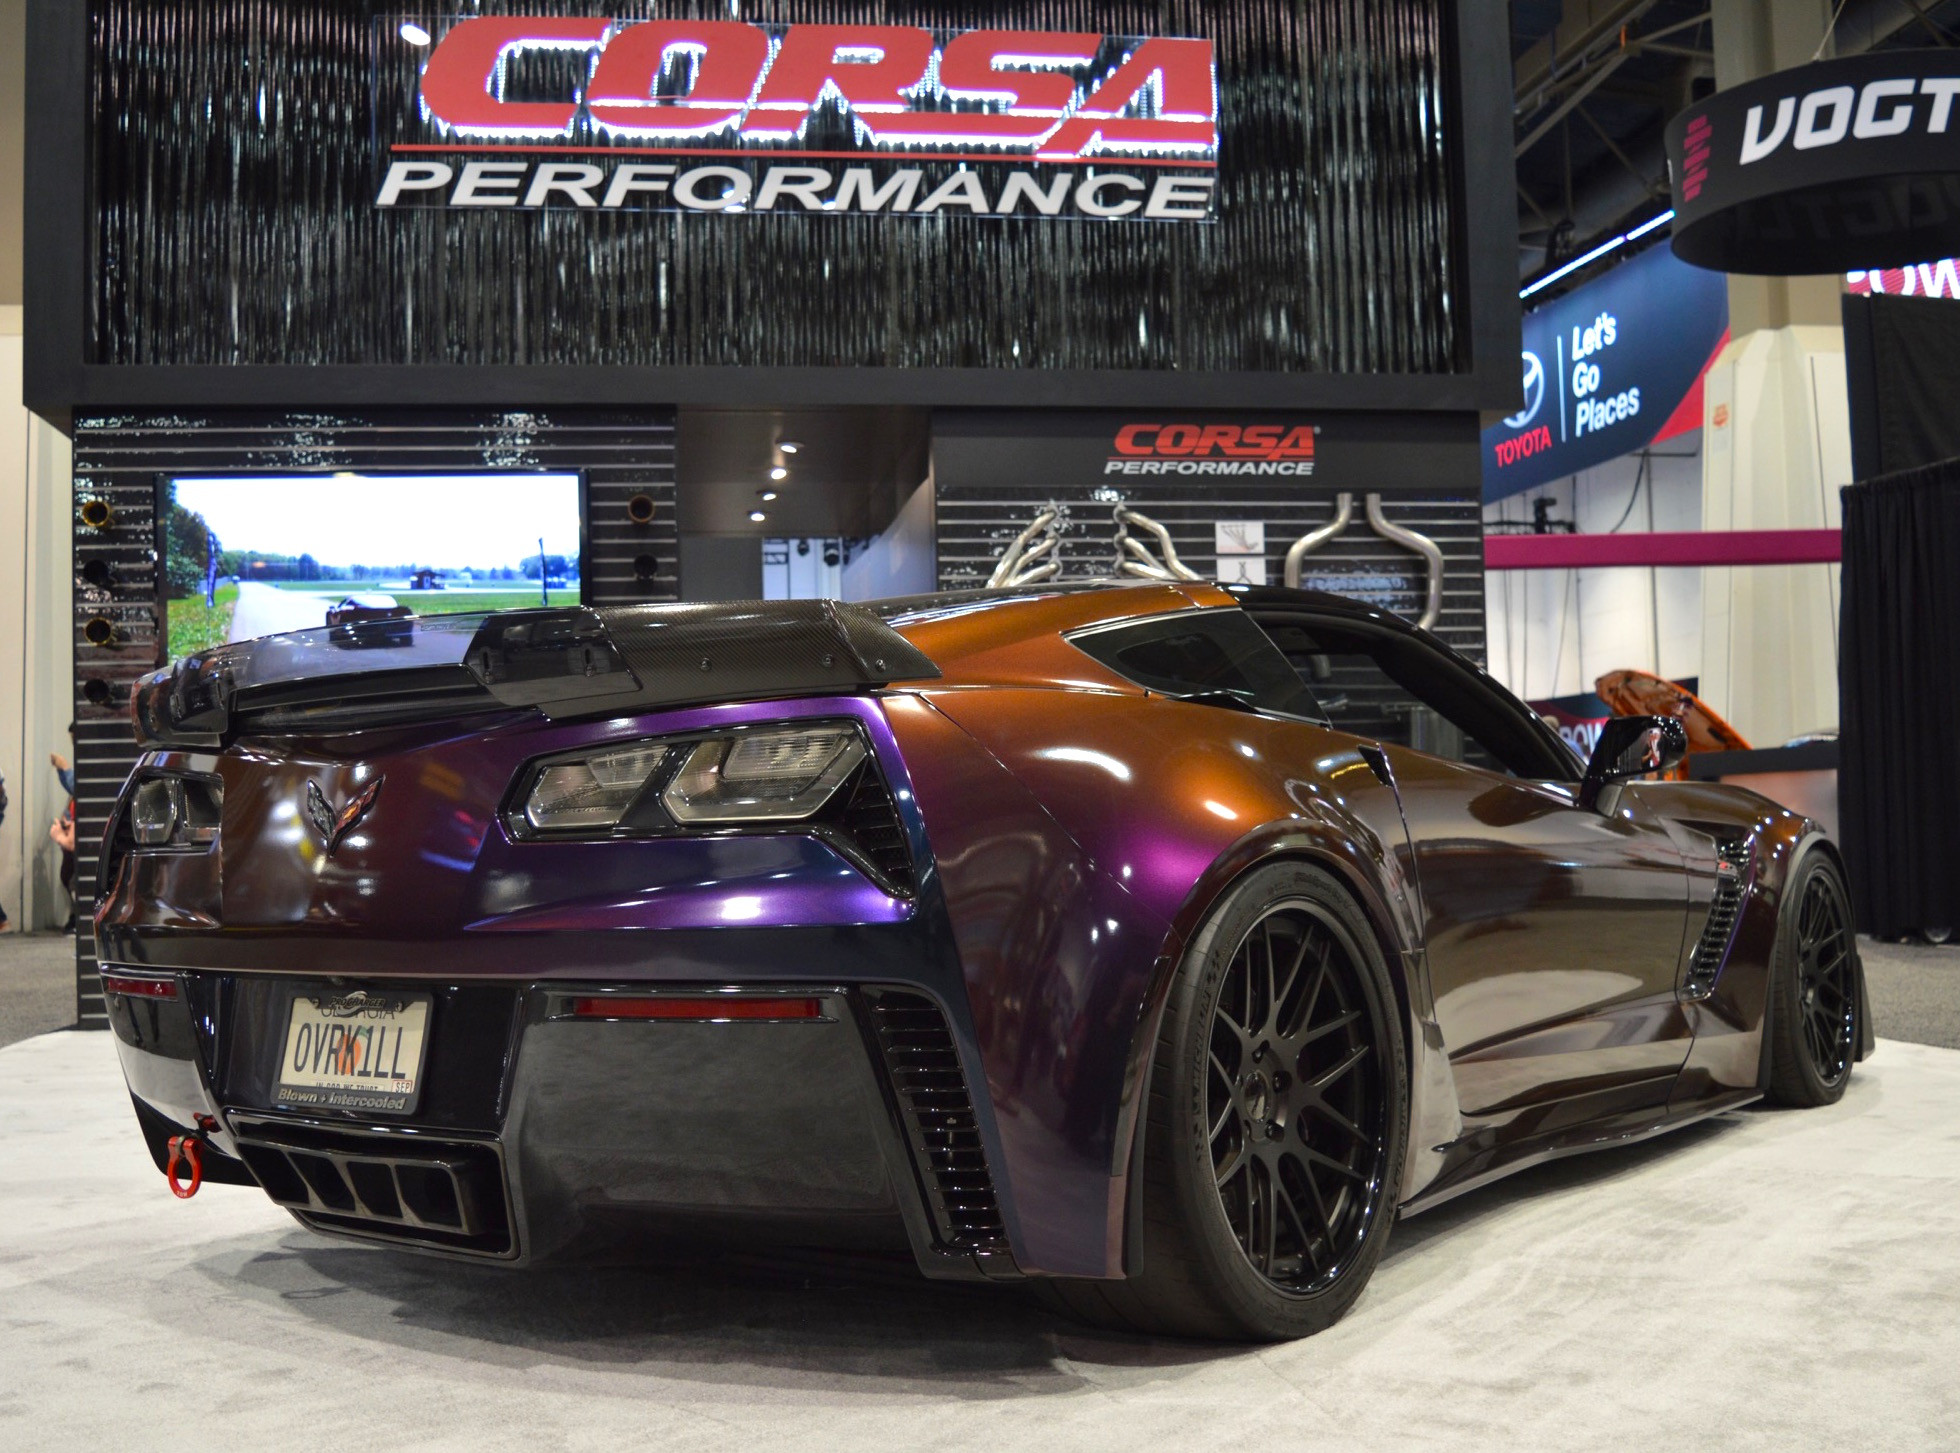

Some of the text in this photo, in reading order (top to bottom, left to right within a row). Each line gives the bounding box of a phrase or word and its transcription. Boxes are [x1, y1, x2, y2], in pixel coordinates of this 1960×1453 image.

[419, 15, 1218, 158] CORSA
[376, 161, 1215, 220] PERFORMANCE
[1571, 312, 1617, 361] Let's
[1572, 362, 1600, 398] Go
[1575, 387, 1640, 437] Places
[1114, 424, 1315, 460] CORSA
[1494, 425, 1552, 467] TOYOTA
[1104, 461, 1315, 475] PERFORMANCE
[278, 1088, 318, 1103] Blown
